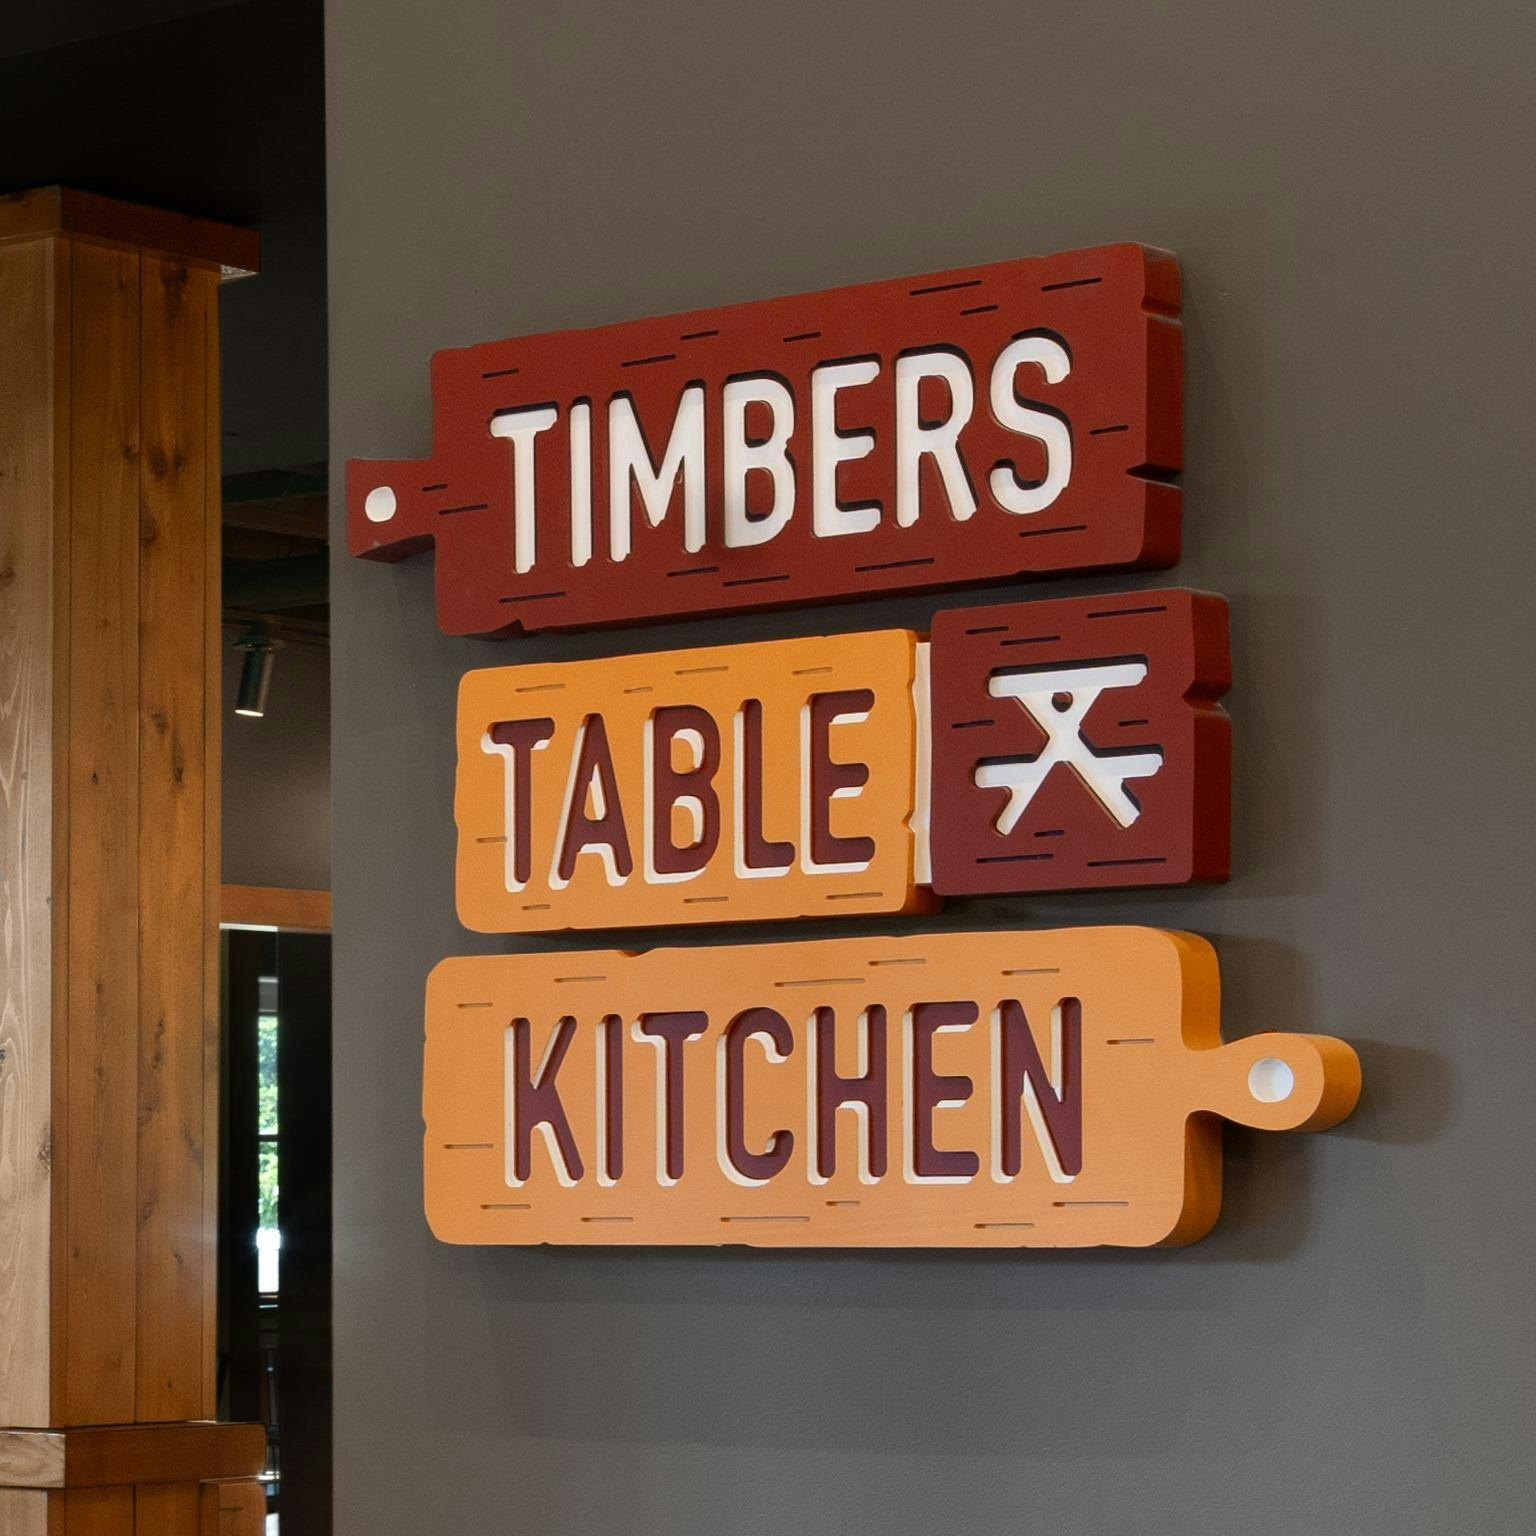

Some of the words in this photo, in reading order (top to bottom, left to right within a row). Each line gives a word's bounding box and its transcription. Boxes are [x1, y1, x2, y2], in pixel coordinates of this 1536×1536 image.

[489, 331, 1074, 574] TIMBERS
[480, 688, 877, 893] TABLE
[502, 996, 1085, 1189] KITCHEN
